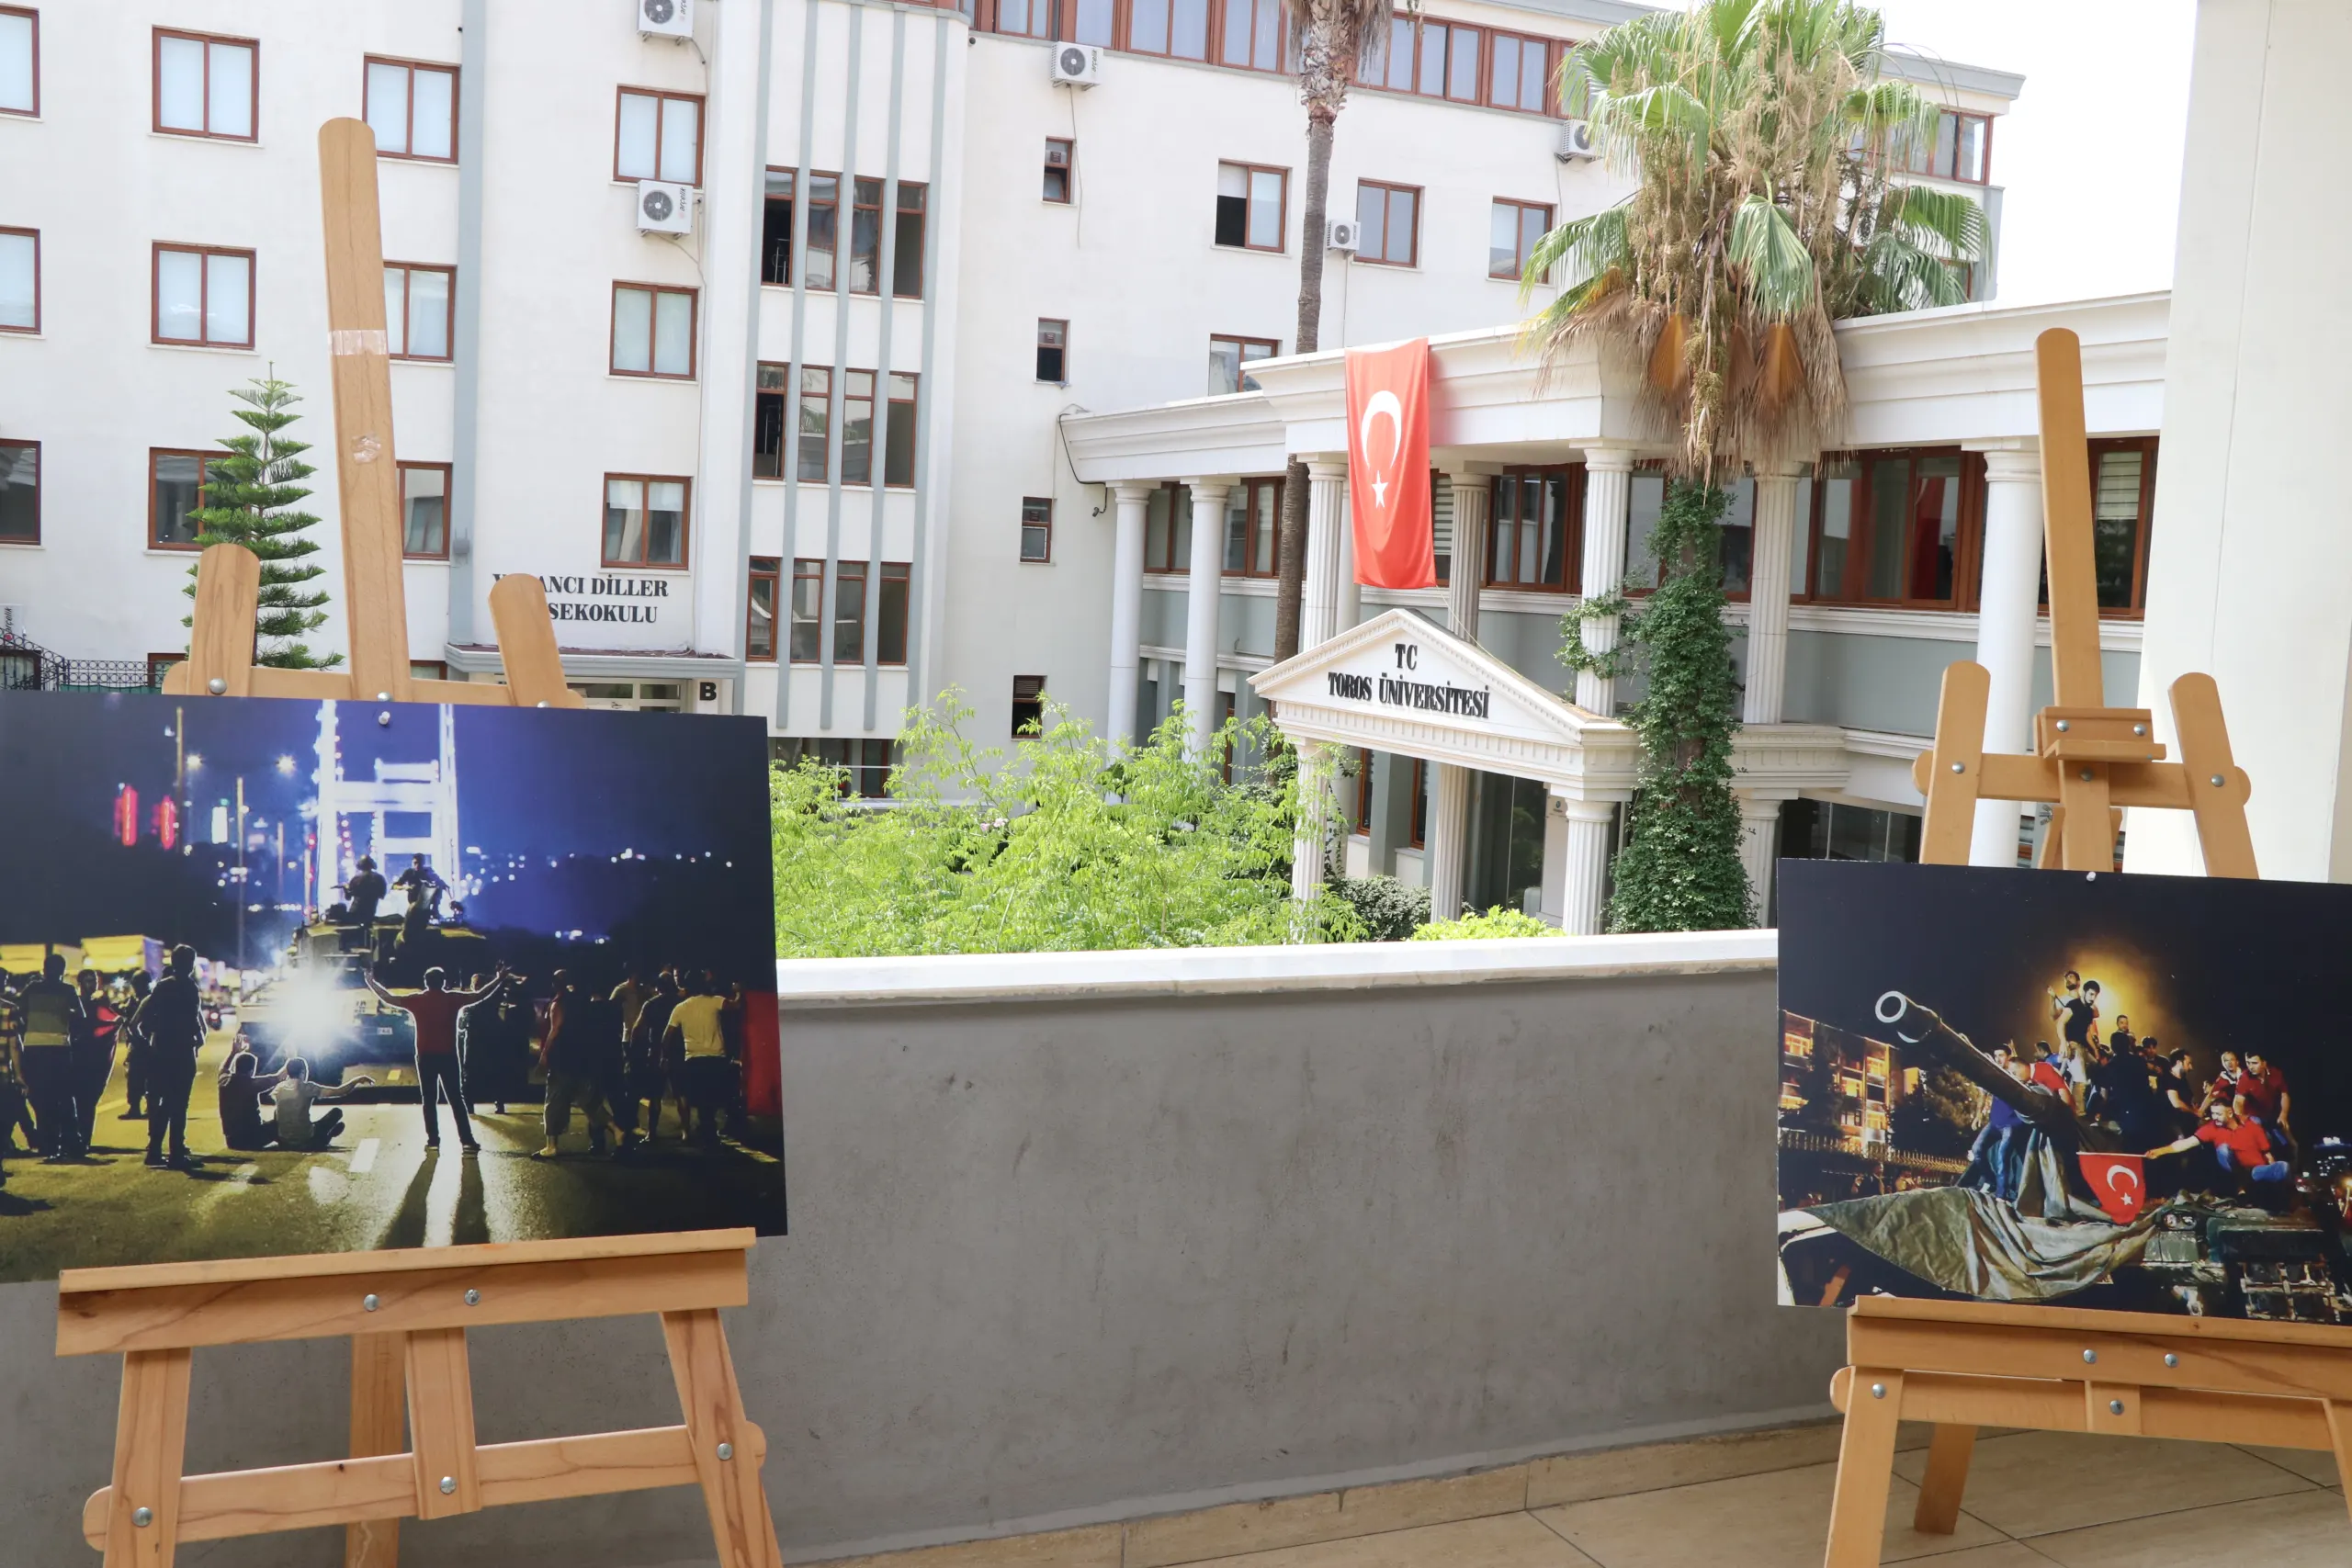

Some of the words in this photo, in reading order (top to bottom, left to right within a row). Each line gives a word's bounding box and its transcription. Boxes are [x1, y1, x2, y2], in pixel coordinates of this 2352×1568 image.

[591, 574, 669, 597] DİLLER
[548, 602, 658, 623] SEKOKULU
[699, 682, 717, 701] B
[1328, 671, 1373, 701] TOROS
[1378, 672, 1489, 718] ÜNİVERSİTESİ
